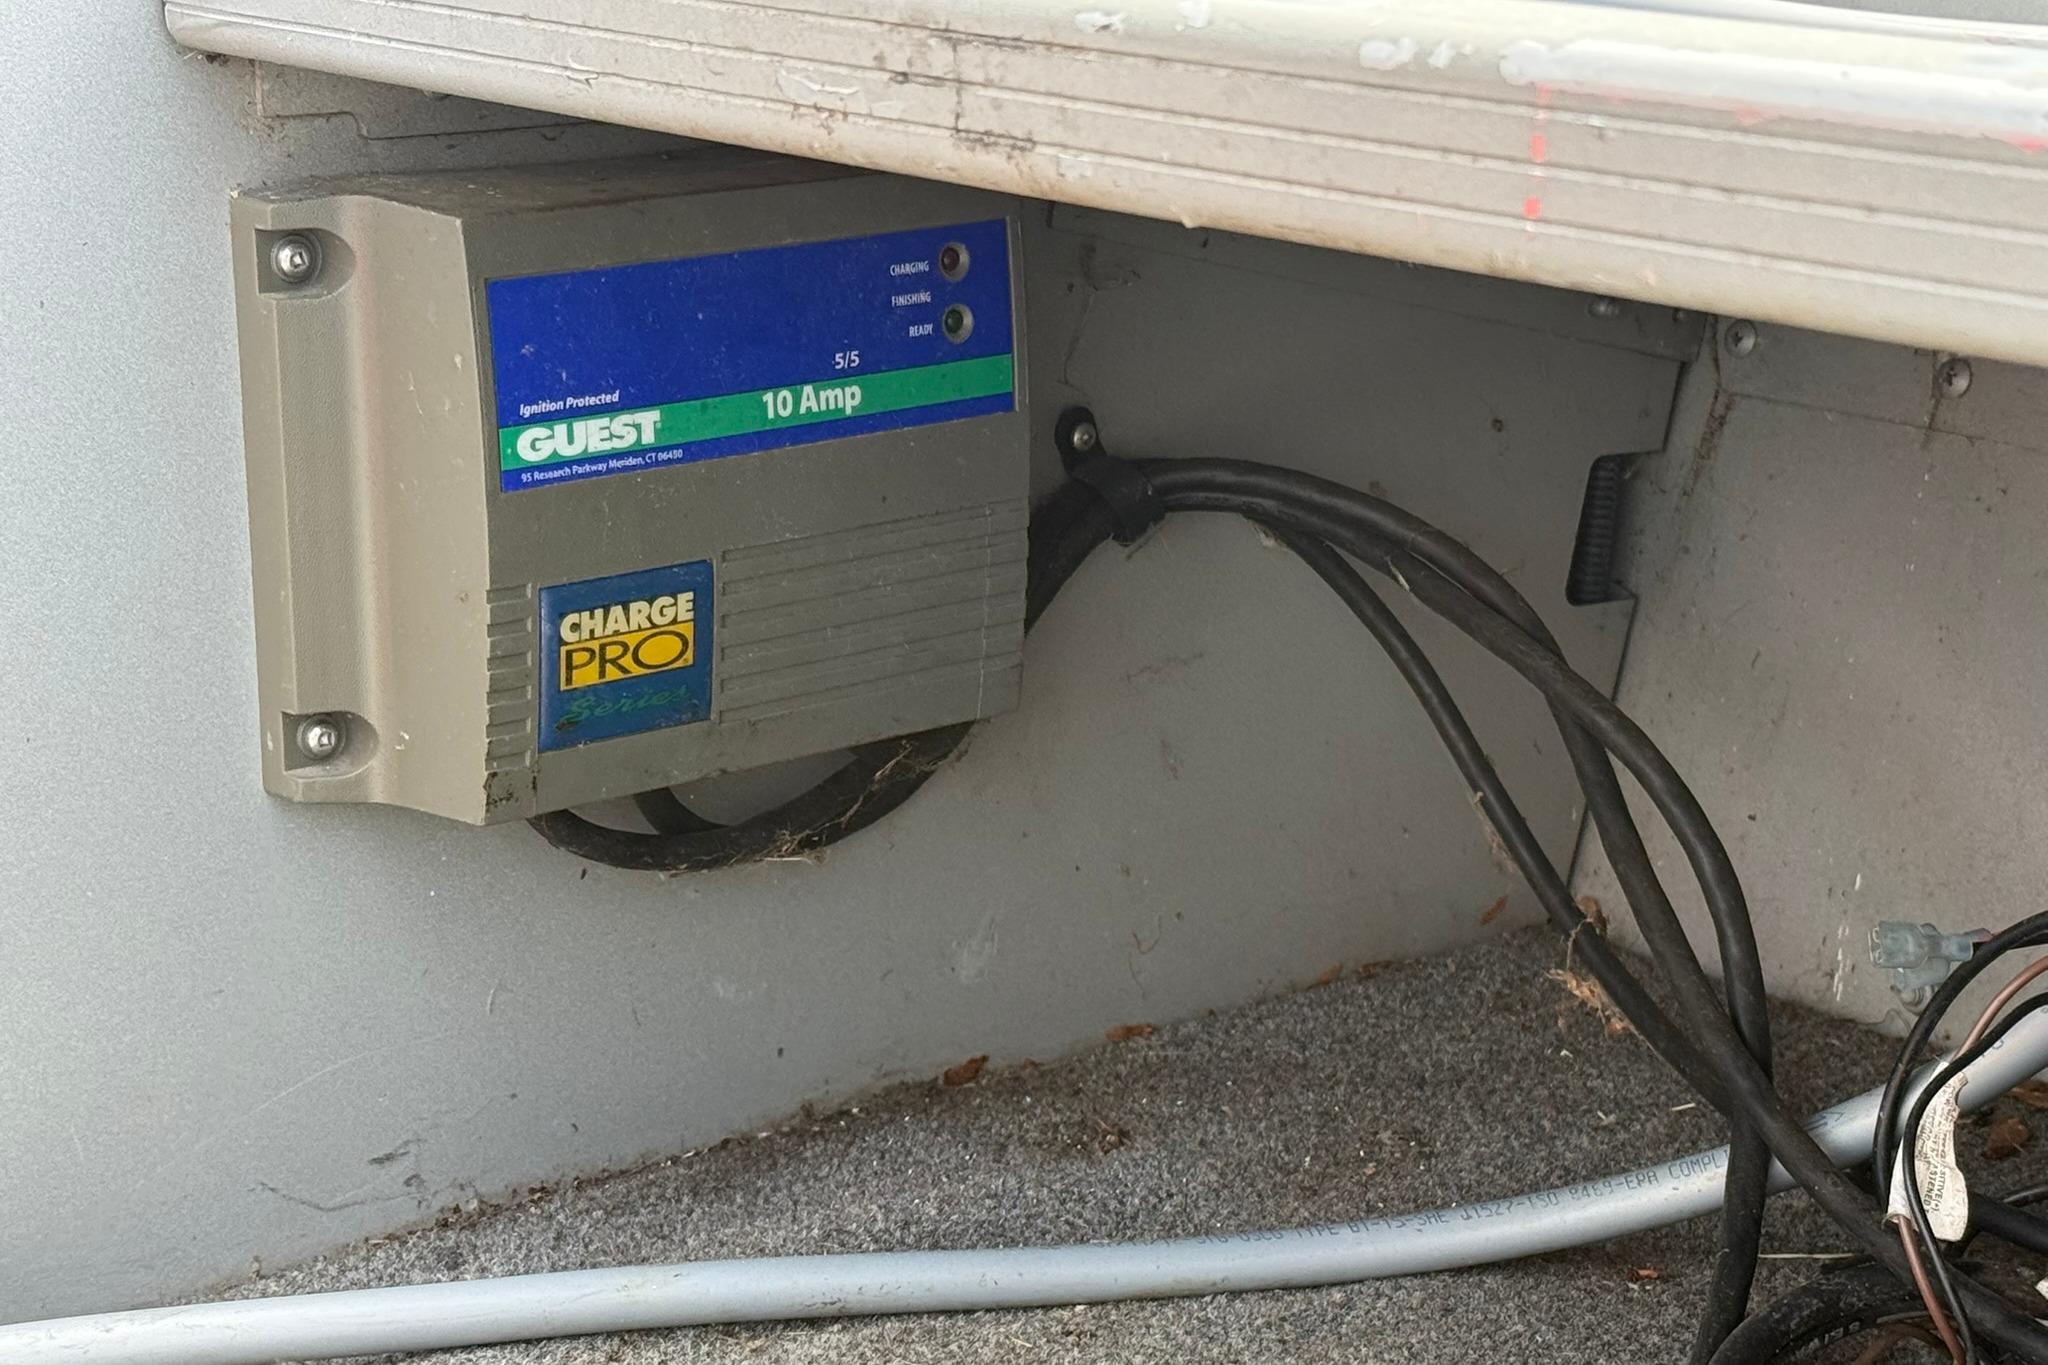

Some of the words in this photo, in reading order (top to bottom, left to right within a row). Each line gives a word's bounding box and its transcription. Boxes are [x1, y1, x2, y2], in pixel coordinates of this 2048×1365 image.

[889, 260, 930, 276] CHARGING
[891, 291, 931, 307] FINISHING
[909, 323, 934, 337] READY
[834, 350, 860, 370] 5/5
[519, 399, 564, 418] Ignition
[566, 389, 620, 408] Protected
[762, 389, 794, 420] 10
[799, 384, 862, 415] Amp
[517, 409, 661, 462] GUEST
[521, 472, 532, 483] 95
[534, 467, 571, 482] Research
[573, 462, 608, 478] Parkway
[645, 452, 656, 464] CT
[560, 591, 694, 643] CHARGE
[565, 630, 689, 687] PRO
